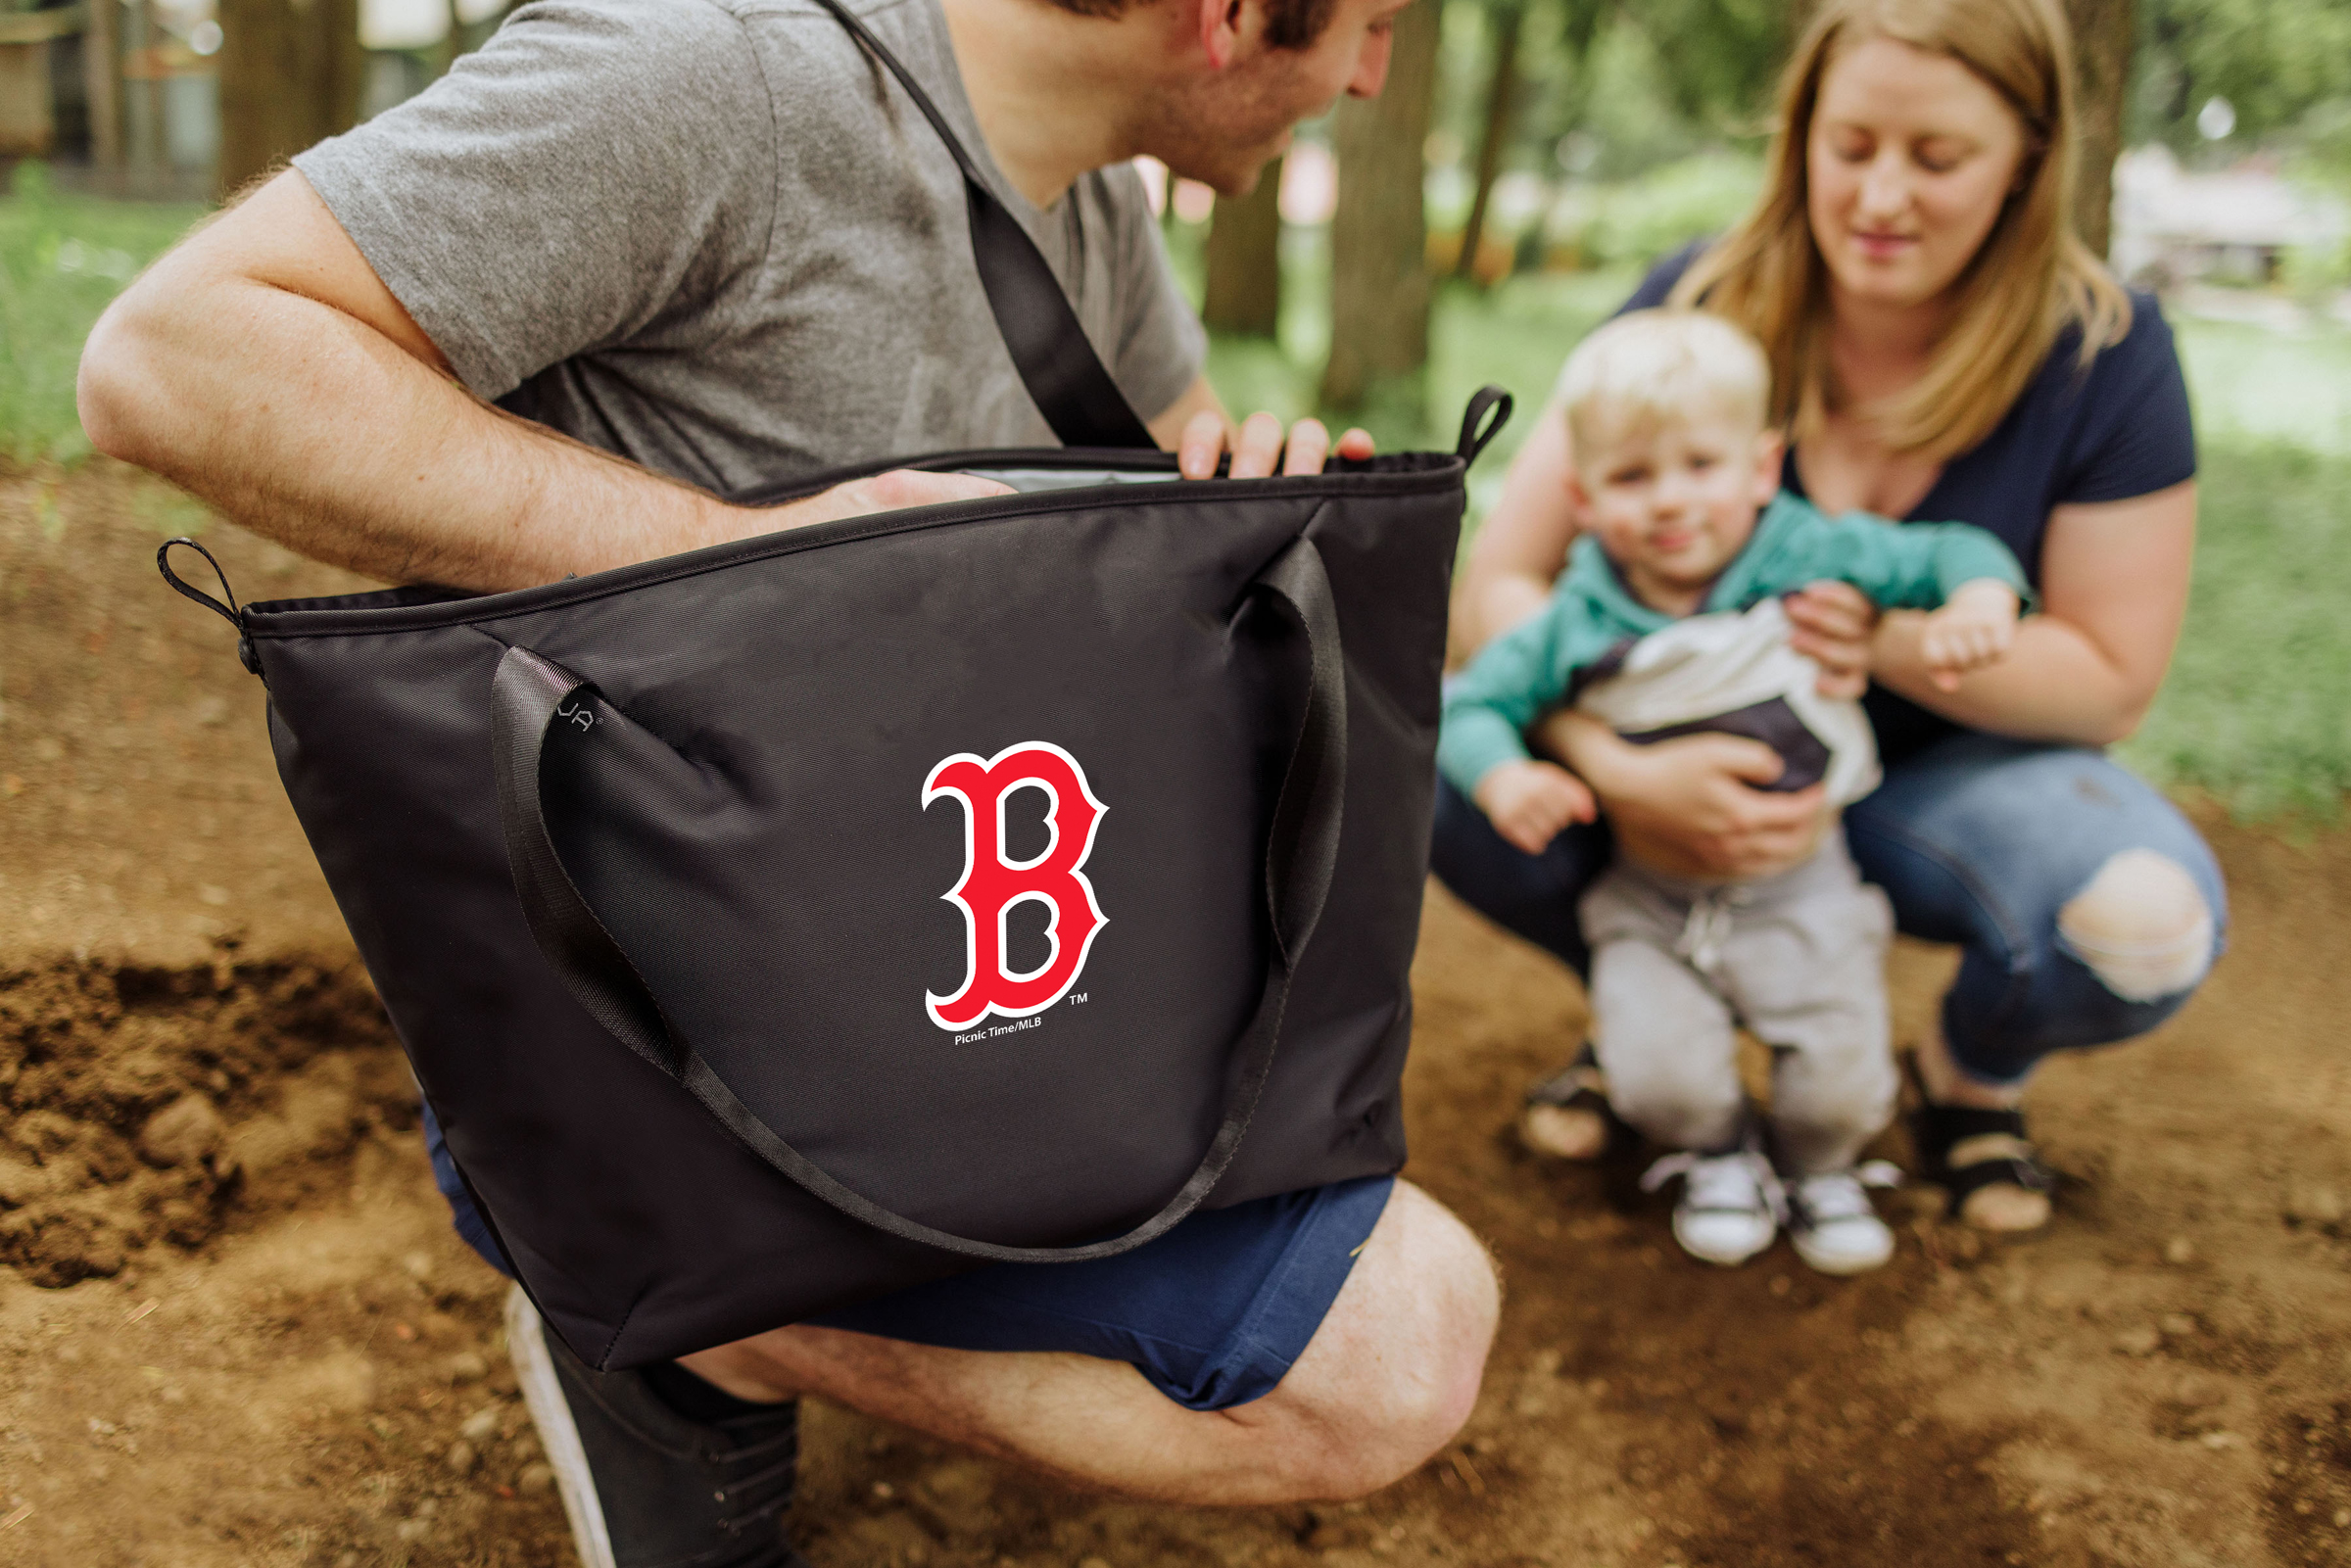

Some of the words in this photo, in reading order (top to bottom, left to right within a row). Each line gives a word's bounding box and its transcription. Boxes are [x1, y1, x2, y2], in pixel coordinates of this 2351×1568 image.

[922, 740, 1110, 1031] B
[1069, 992, 1088, 1006] TM
[954, 1030, 986, 1046] Picnic
[987, 1017, 1042, 1037] Time/MLB
